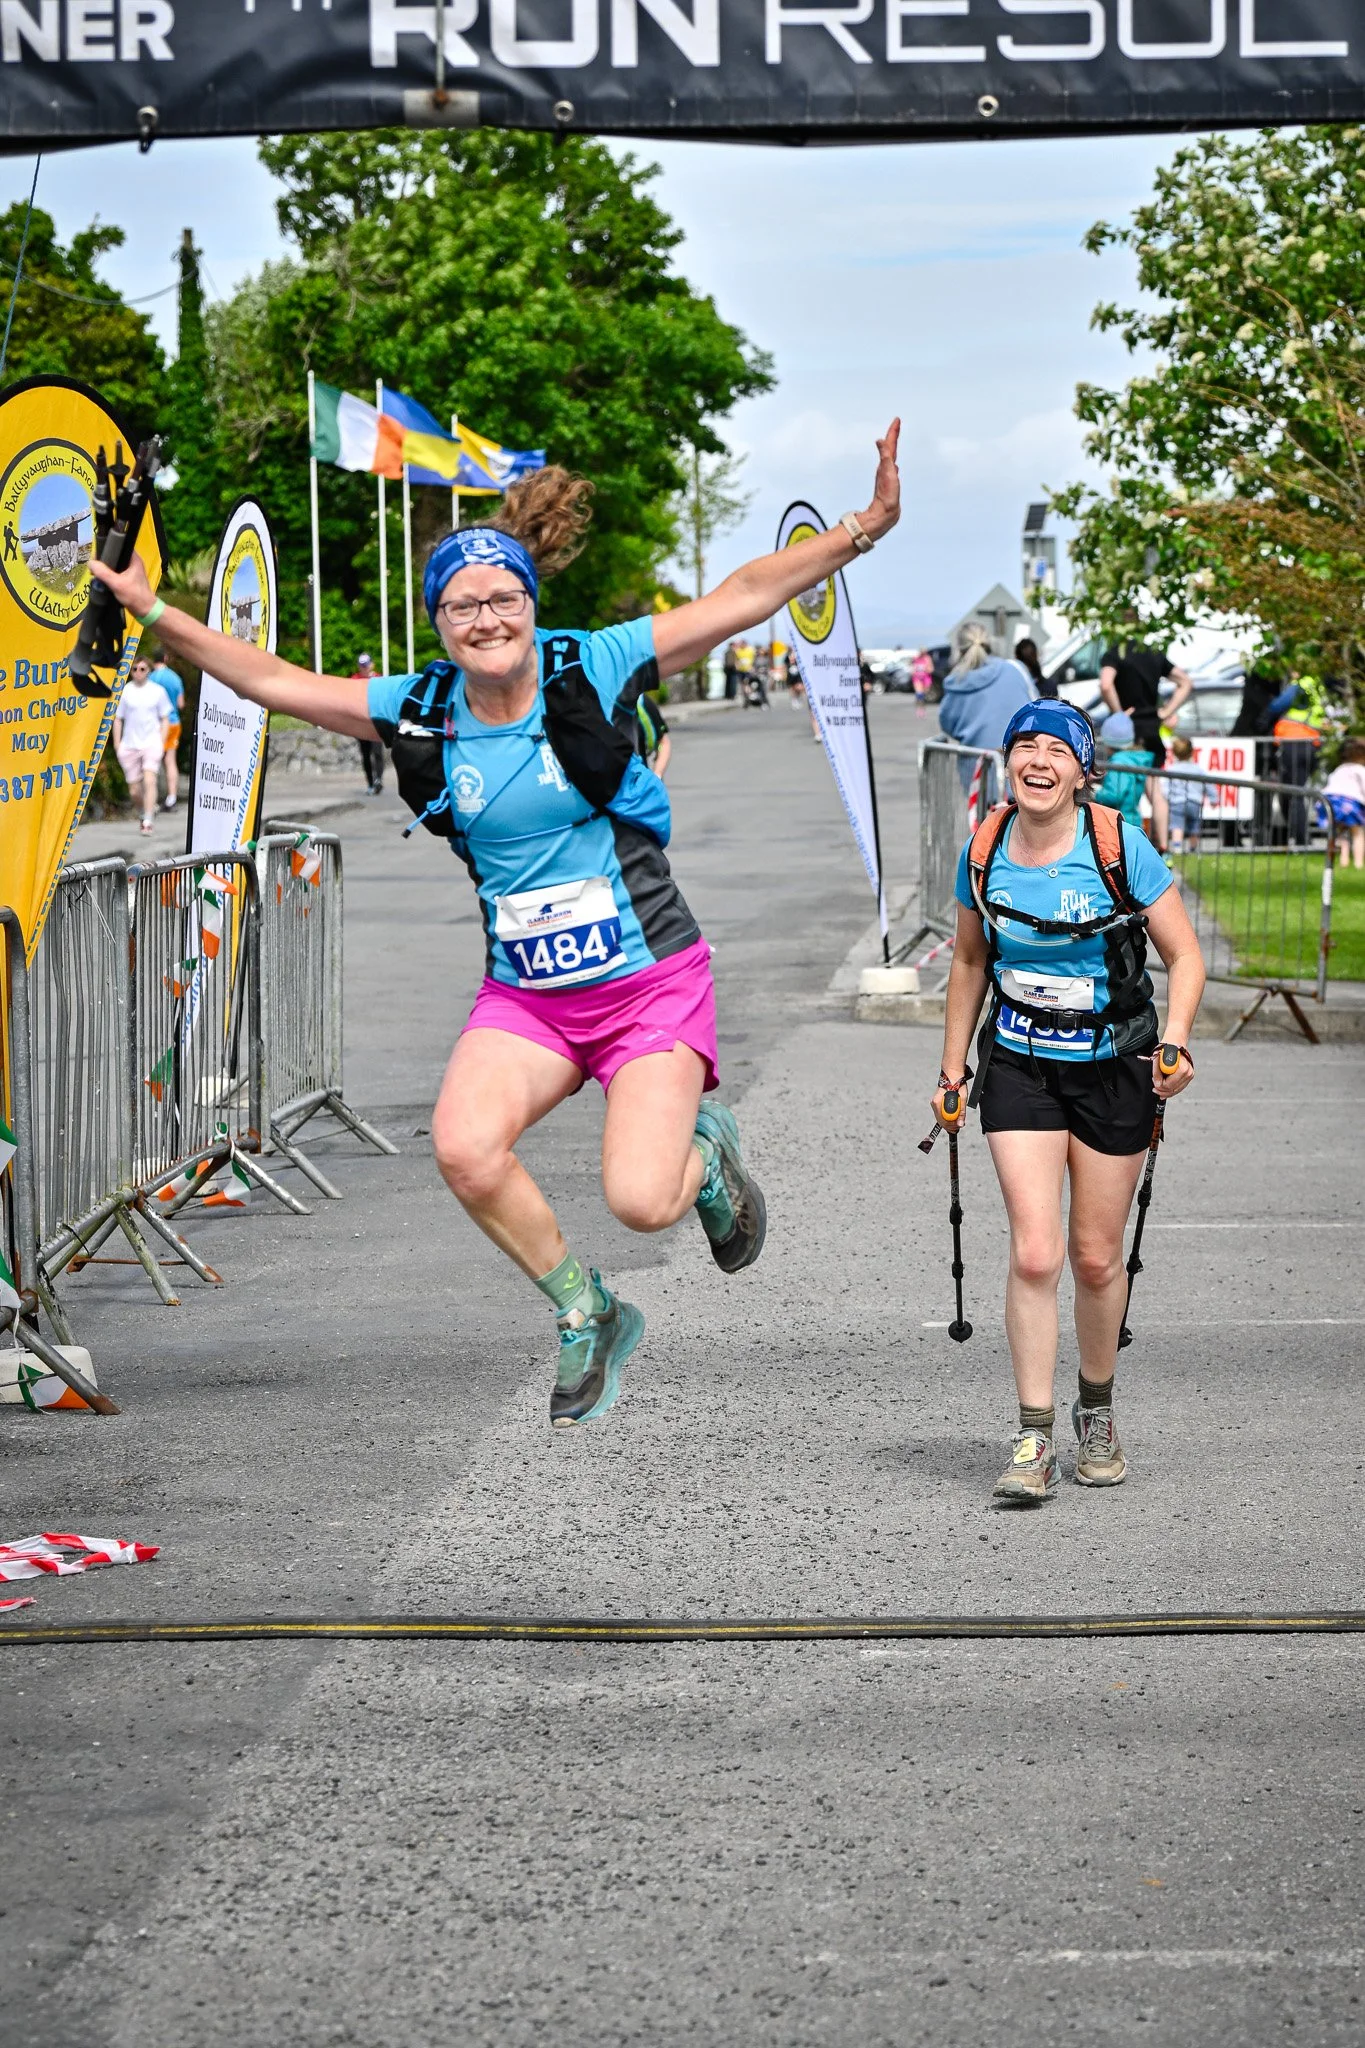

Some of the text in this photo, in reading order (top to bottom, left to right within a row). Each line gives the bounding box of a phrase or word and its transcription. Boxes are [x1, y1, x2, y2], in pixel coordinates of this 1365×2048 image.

[370, 0, 720, 68] RUN
[4, 455, 95, 513] Ballyvaughan-Fanor
[12, 732, 50, 754] May
[1208, 748, 1245, 772] AID
[226, 768, 241, 787] Club
[1060, 892, 1089, 911] RUN
[1066, 907, 1099, 924] LNE
[513, 924, 609, 977] 1484
